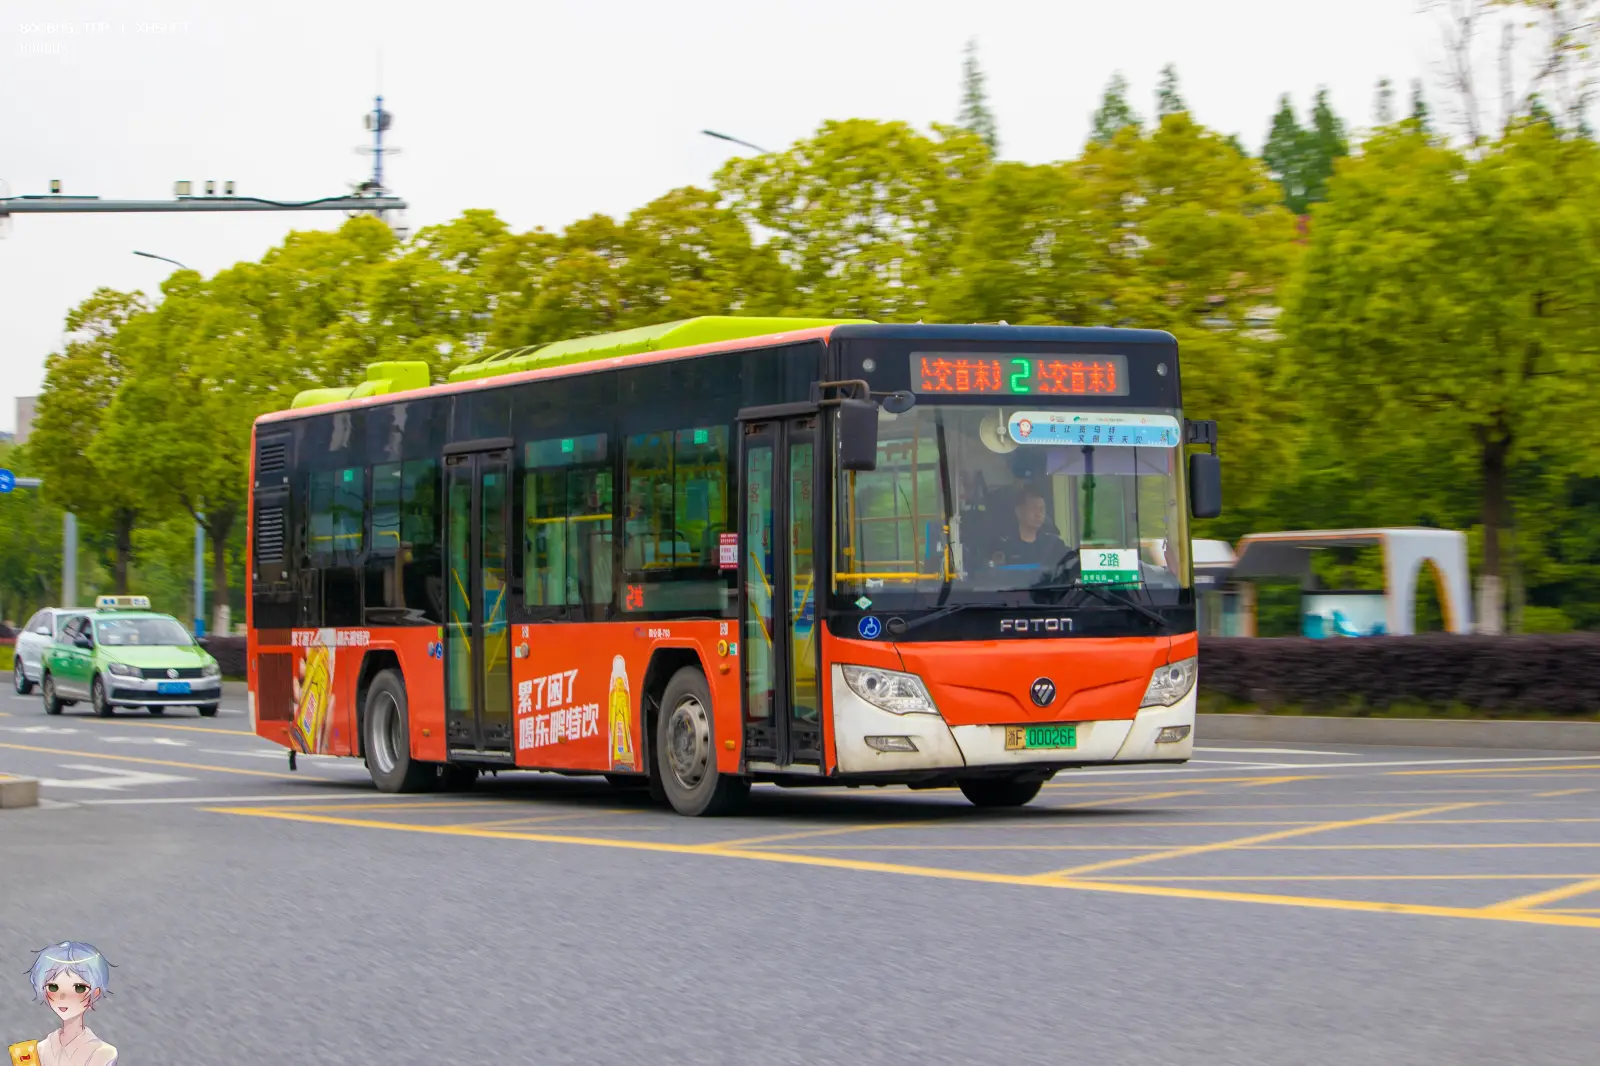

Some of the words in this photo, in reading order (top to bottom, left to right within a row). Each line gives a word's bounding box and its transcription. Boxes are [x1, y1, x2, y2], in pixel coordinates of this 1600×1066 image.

[1011, 359, 1029, 392] 2
[1099, 553, 1120, 567] 2路
[1000, 618, 1073, 632] FOTON
[518, 668, 579, 714] 累了困了
[519, 702, 599, 750] 喝东鹏特饮
